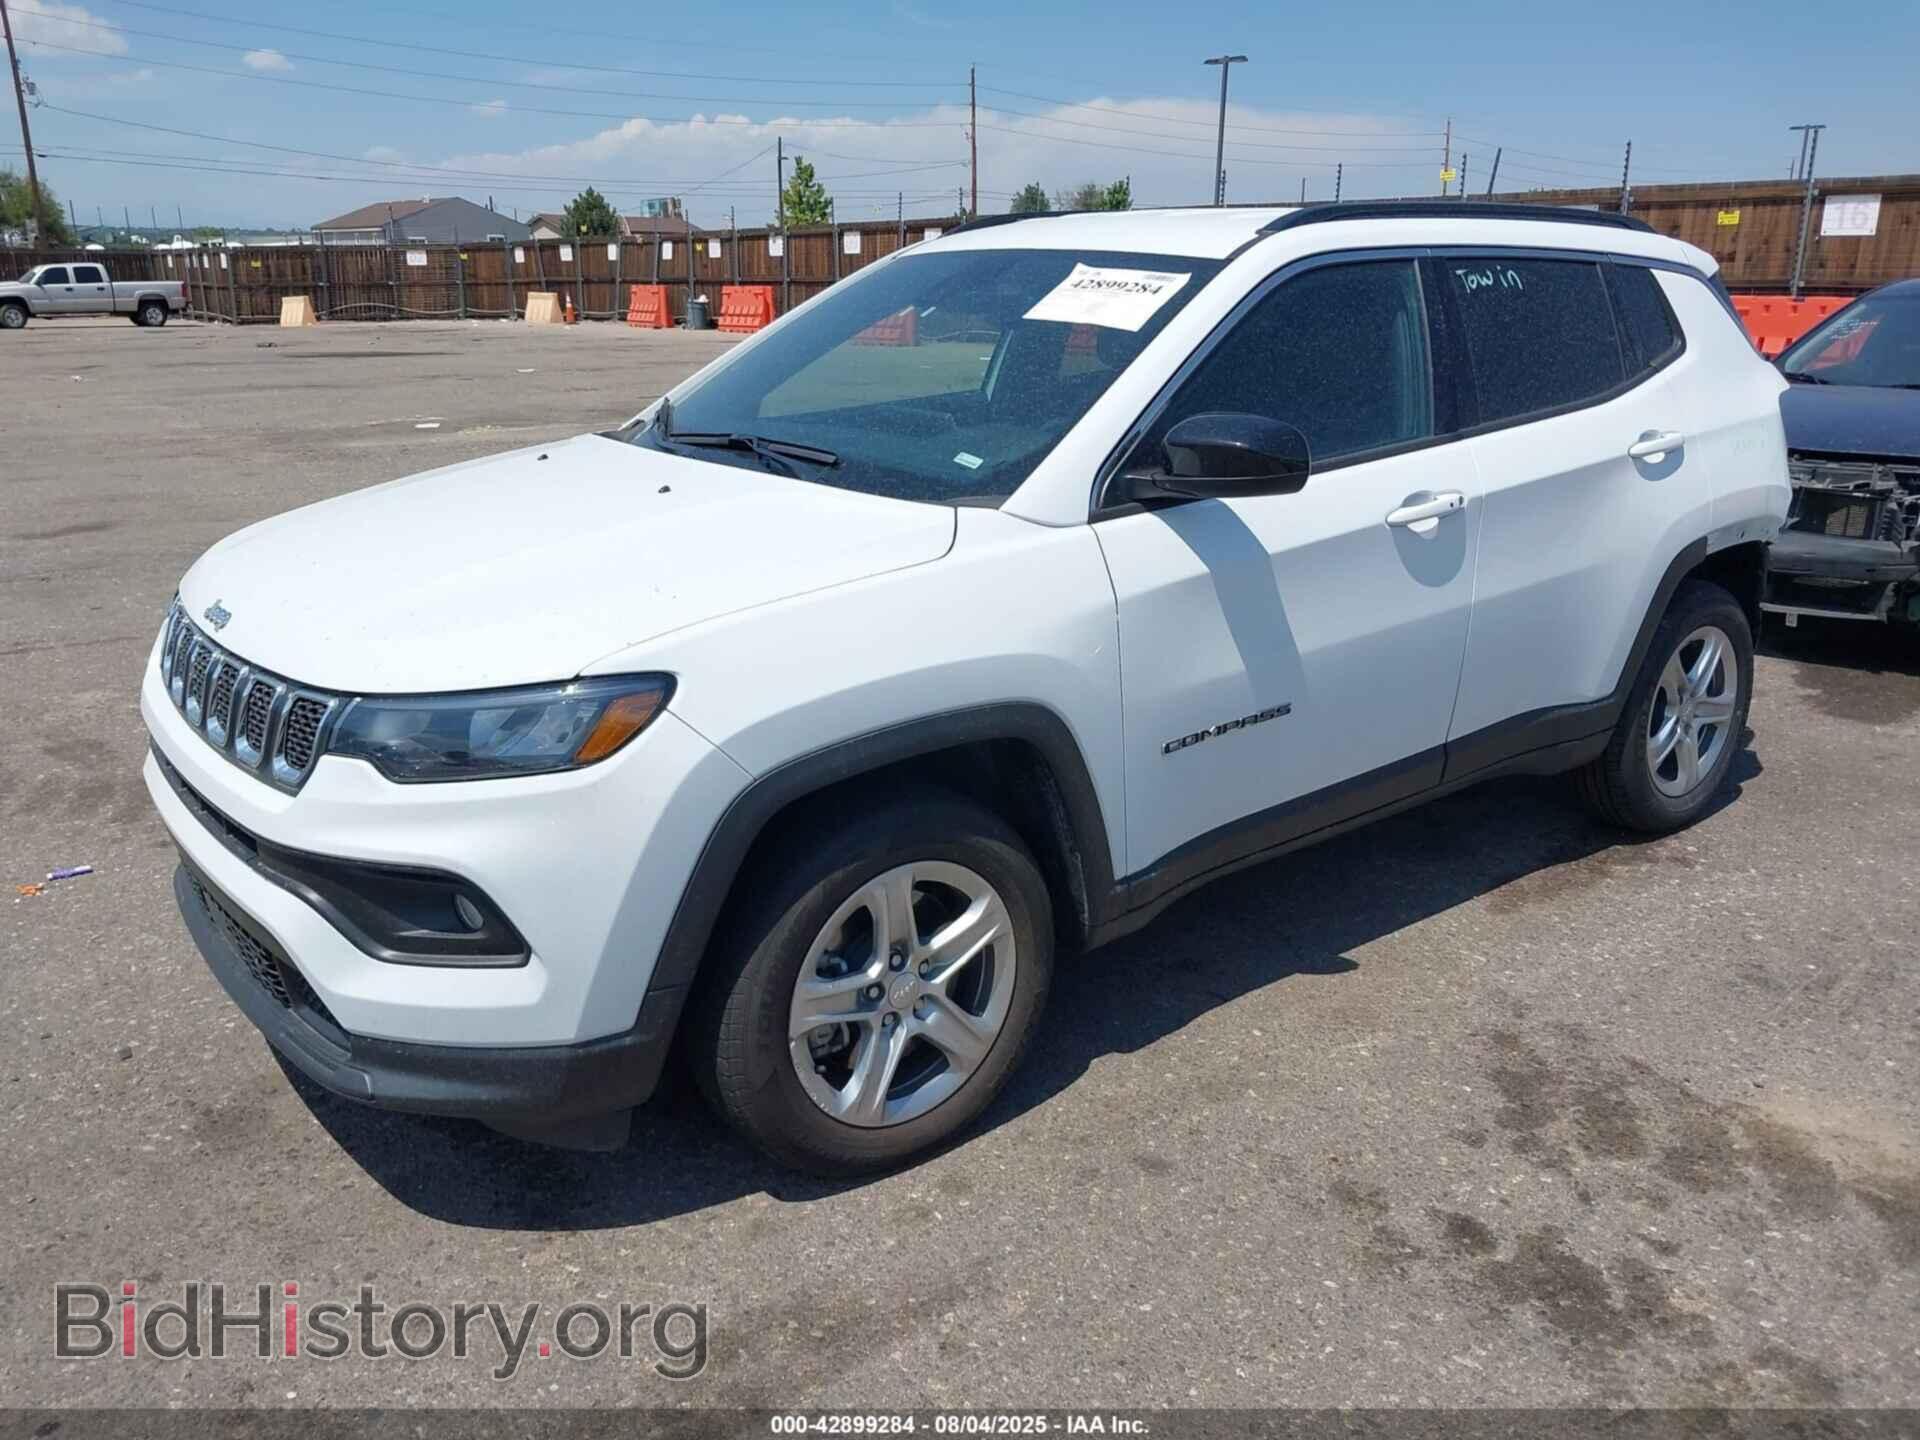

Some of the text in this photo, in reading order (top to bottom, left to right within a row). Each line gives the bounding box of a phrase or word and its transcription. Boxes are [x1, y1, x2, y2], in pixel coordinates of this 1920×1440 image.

[1070, 278, 1163, 295] 42899284
[1455, 265, 1523, 293] Tow in
[1161, 702, 1292, 754] COMPASS
